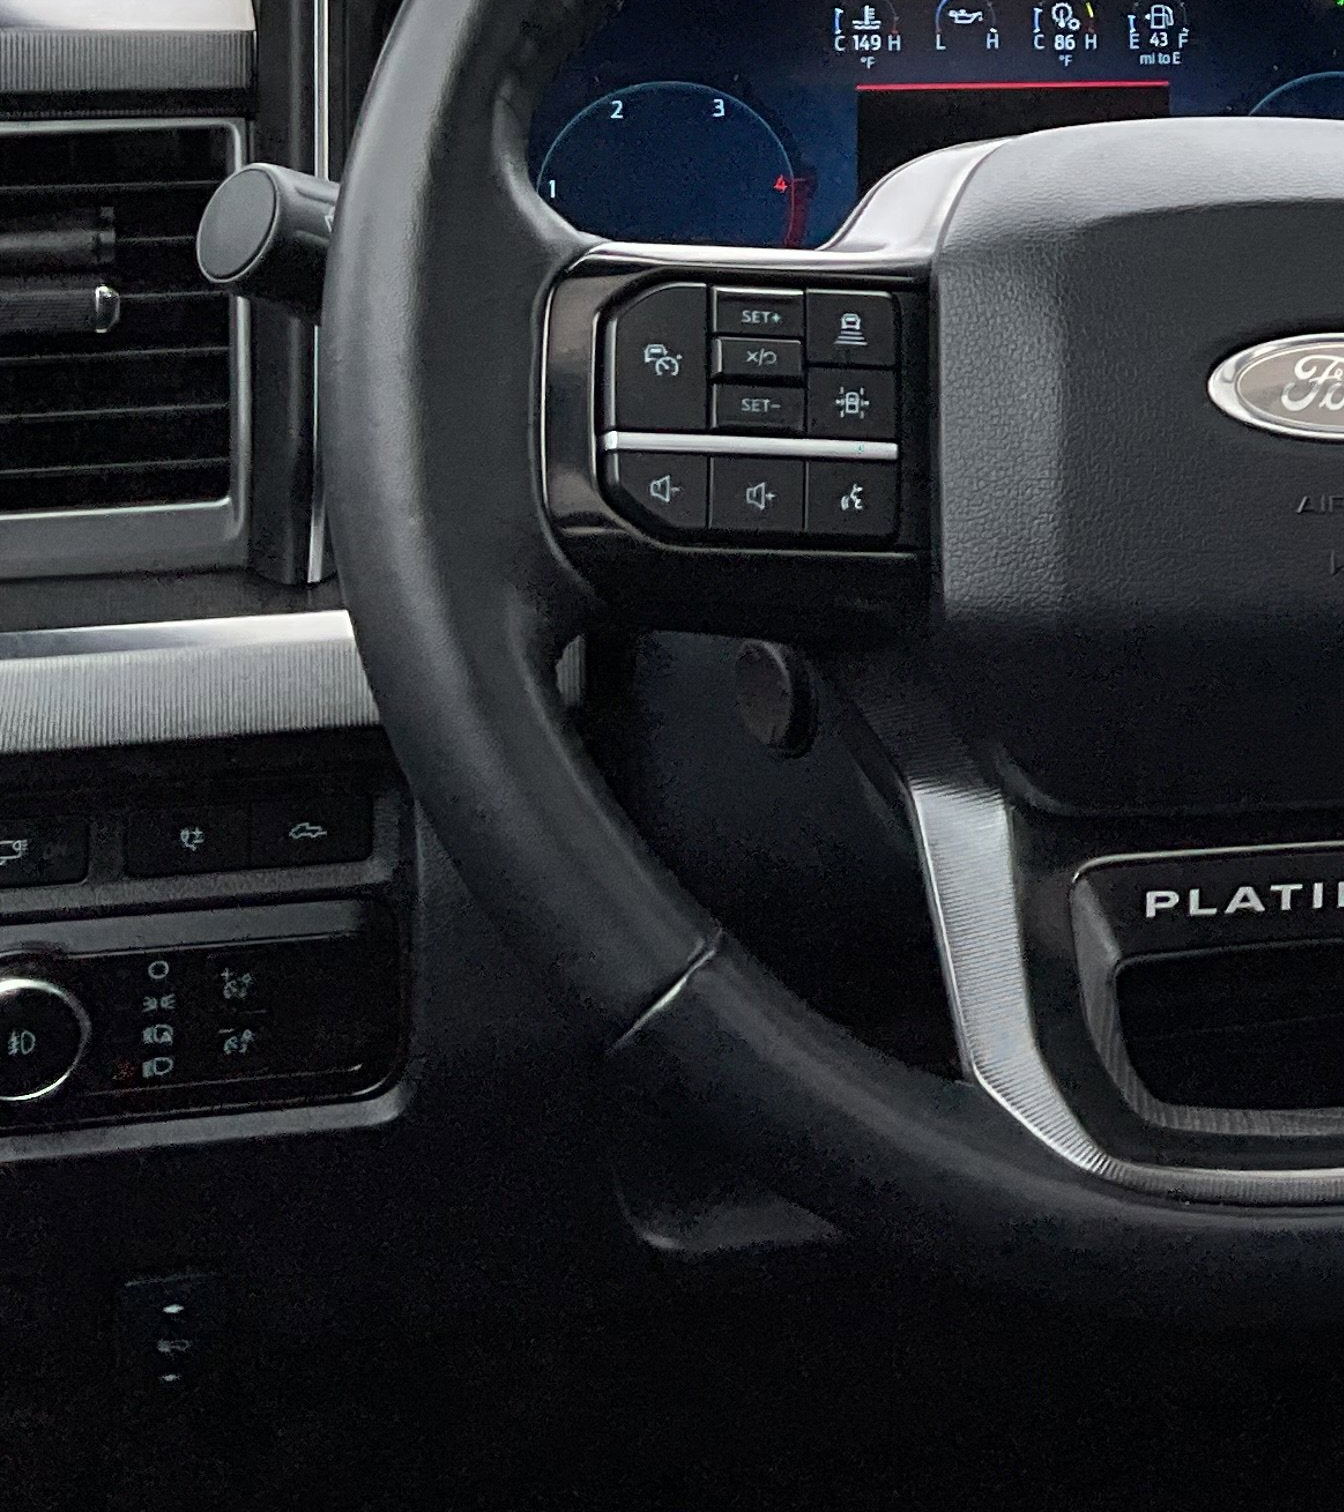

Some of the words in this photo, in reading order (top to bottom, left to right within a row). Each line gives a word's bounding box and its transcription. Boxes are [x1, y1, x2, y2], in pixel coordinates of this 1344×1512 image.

[835, 35, 846, 51] C
[853, 34, 881, 50] 149
[888, 35, 900, 51] H
[936, 34, 946, 50] L
[987, 33, 999, 49] H
[1034, 34, 1045, 50] C
[1054, 34, 1076, 50] 86
[1085, 33, 1097, 49] H
[1129, 33, 1140, 49] E
[1150, 31, 1168, 46] 43
[1178, 33, 1189, 48] F
[1157, 52, 1171, 64] to
[1172, 52, 1181, 64] E
[610, 100, 624, 119] 2
[712, 99, 725, 117] 3
[549, 179, 556, 198] 1
